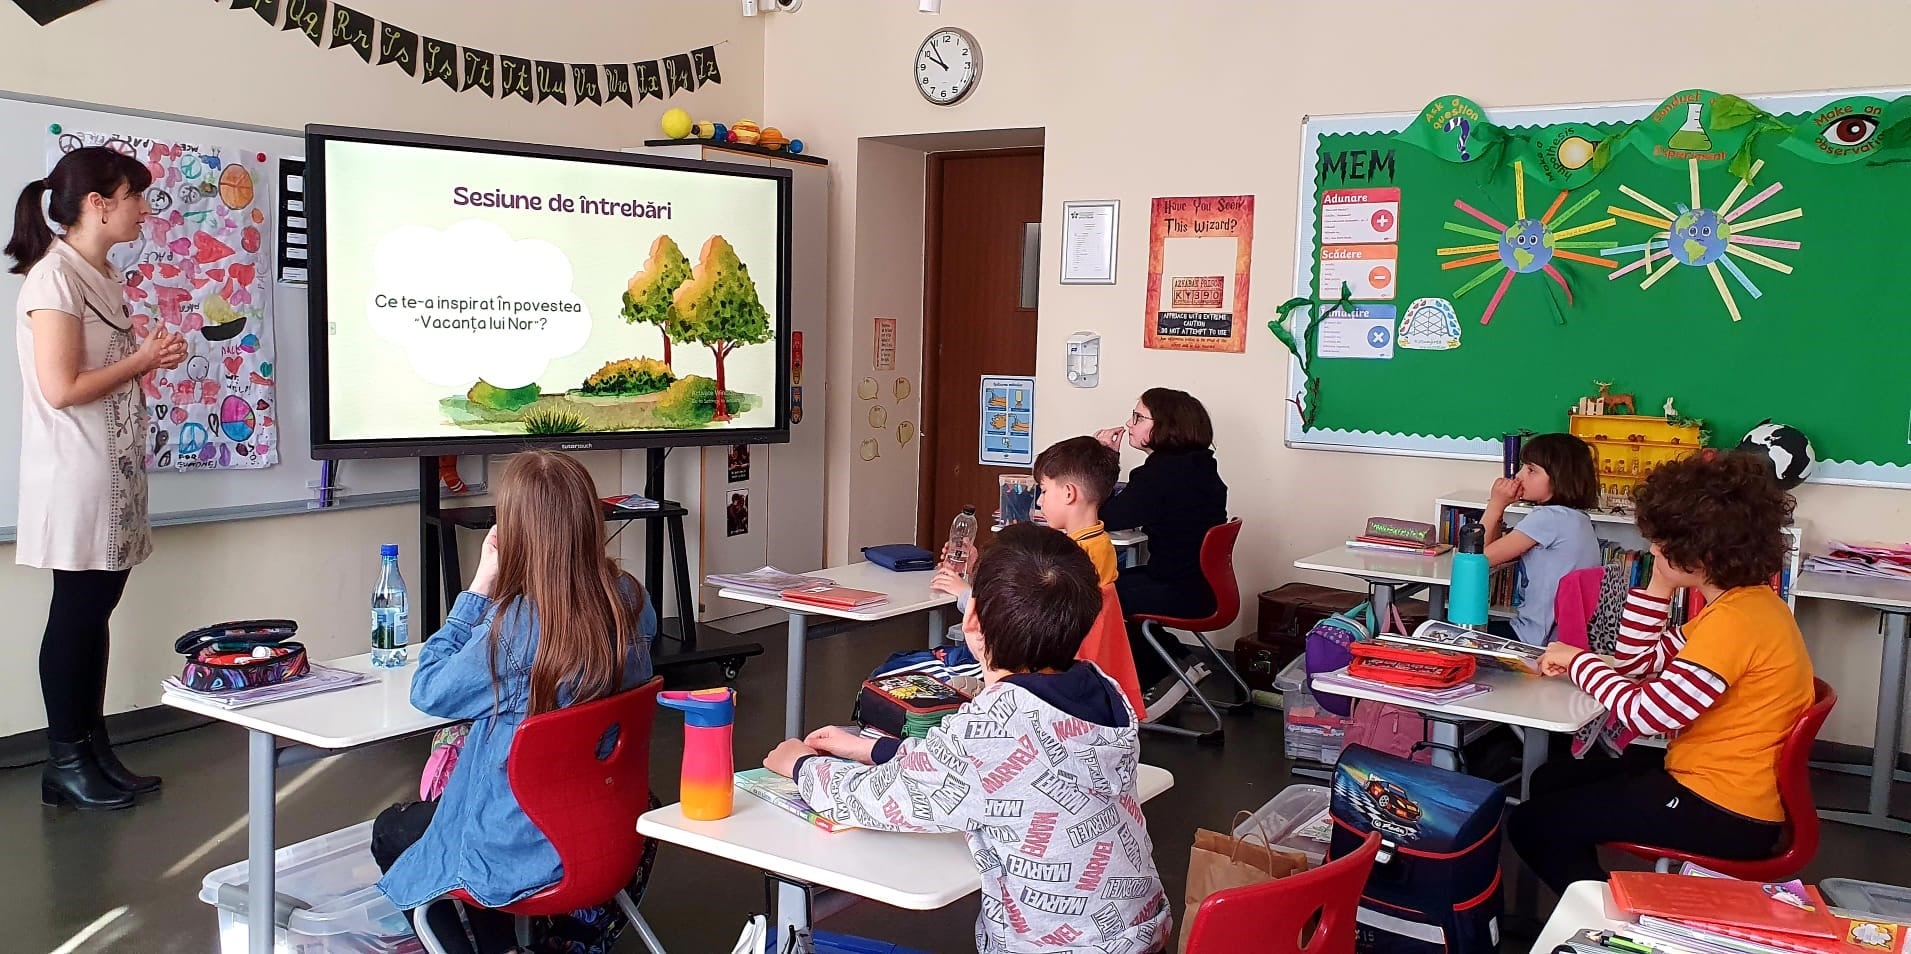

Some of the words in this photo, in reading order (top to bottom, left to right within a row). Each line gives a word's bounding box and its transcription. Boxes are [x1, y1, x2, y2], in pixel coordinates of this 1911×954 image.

[942, 35, 951, 43] 12
[924, 50, 931, 58] 10
[962, 48, 969, 56] 2
[920, 63, 927, 71] 9
[964, 61, 971, 69] 3
[930, 86, 936, 94] 7
[940, 90, 947, 98] 6
[1426, 102, 1444, 123] Ask
[1452, 98, 1460, 106] a
[1434, 103, 1479, 130] question
[1815, 105, 1853, 126] Make
[1864, 105, 1882, 115] an
[1546, 127, 1575, 182] hypothesis
[1321, 149, 1396, 187] MEM
[1537, 152, 1554, 182] Make
[453, 186, 542, 211] Sesiune
[548, 193, 575, 213] de
[579, 195, 673, 220] întrebări
[1164, 199, 1187, 214] Have
[1193, 199, 1211, 215] You
[1323, 193, 1368, 205] Adunare
[1163, 218, 1188, 236] This
[1194, 218, 1238, 234] Wizard?
[1321, 248, 1363, 259] Scădere
[375, 294, 399, 309] Ce
[402, 295, 434, 309] te-a
[437, 296, 495, 314] inspirat
[497, 295, 511, 311] în
[514, 299, 582, 315] povestea
[489, 316, 505, 330] lui
[1066, 802, 1121, 849] MARVEL
[1005, 853, 1073, 882] MARVEL
[1074, 840, 1115, 892] MARVEL
[1019, 885, 1089, 917] MARVEL
